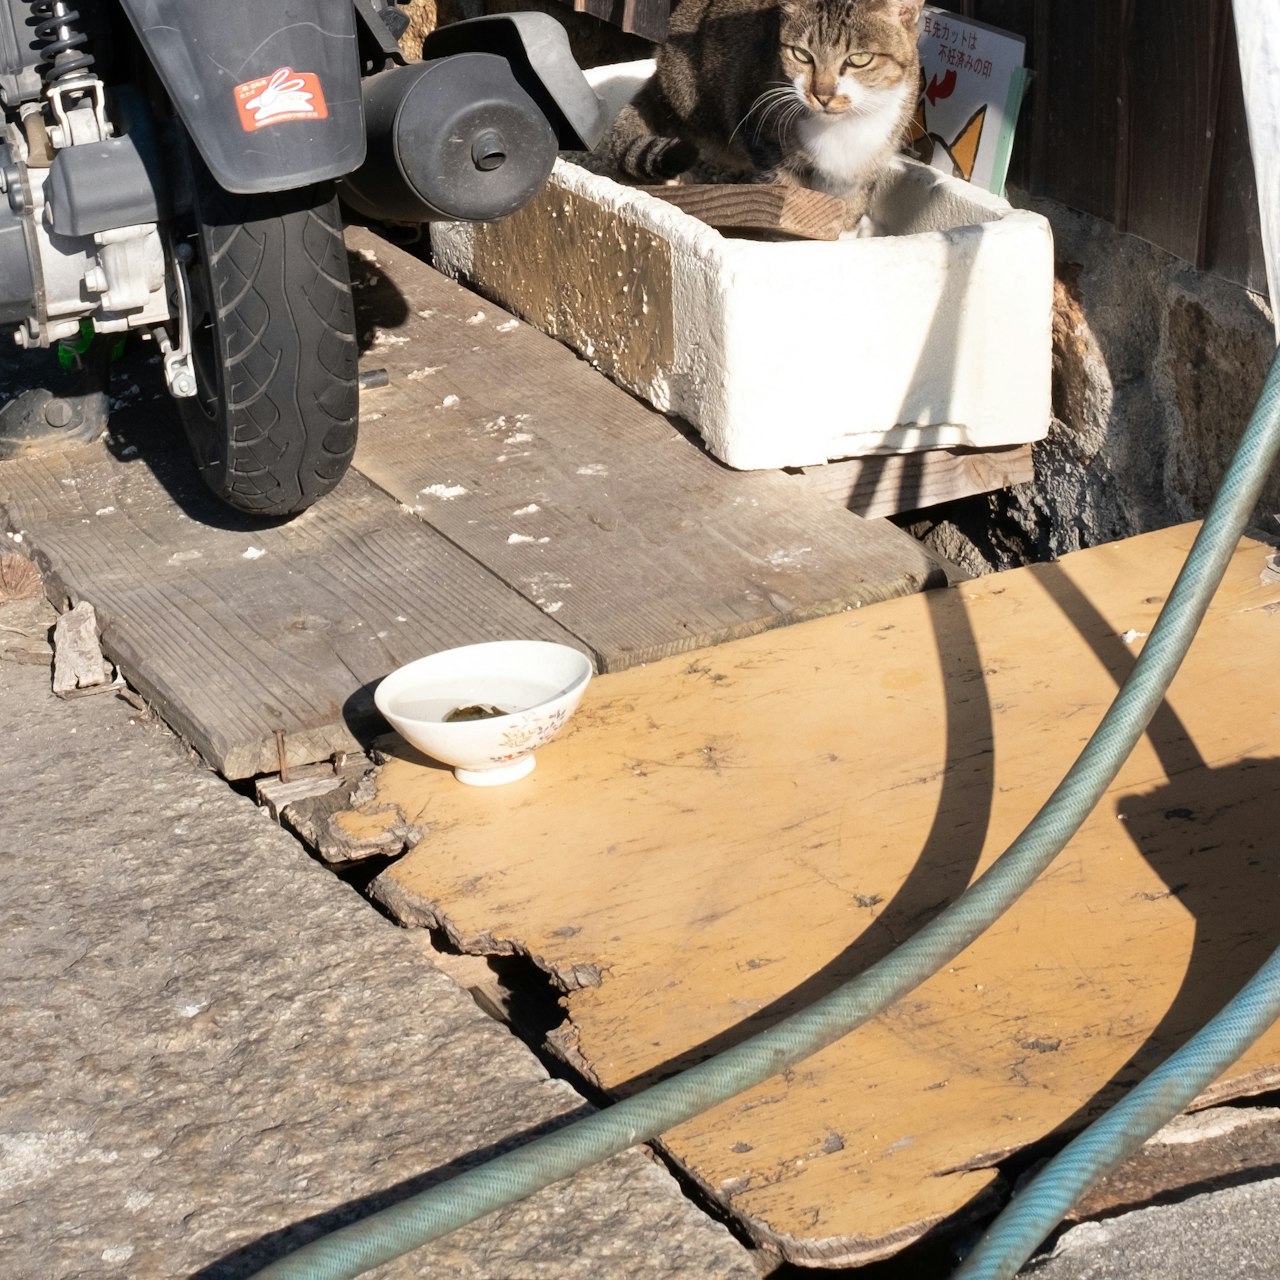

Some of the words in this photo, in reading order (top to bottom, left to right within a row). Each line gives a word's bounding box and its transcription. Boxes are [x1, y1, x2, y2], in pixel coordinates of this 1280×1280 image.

[923, 16, 978, 50] 耳先カットは
[938, 44, 993, 78] 不妊済みの印
